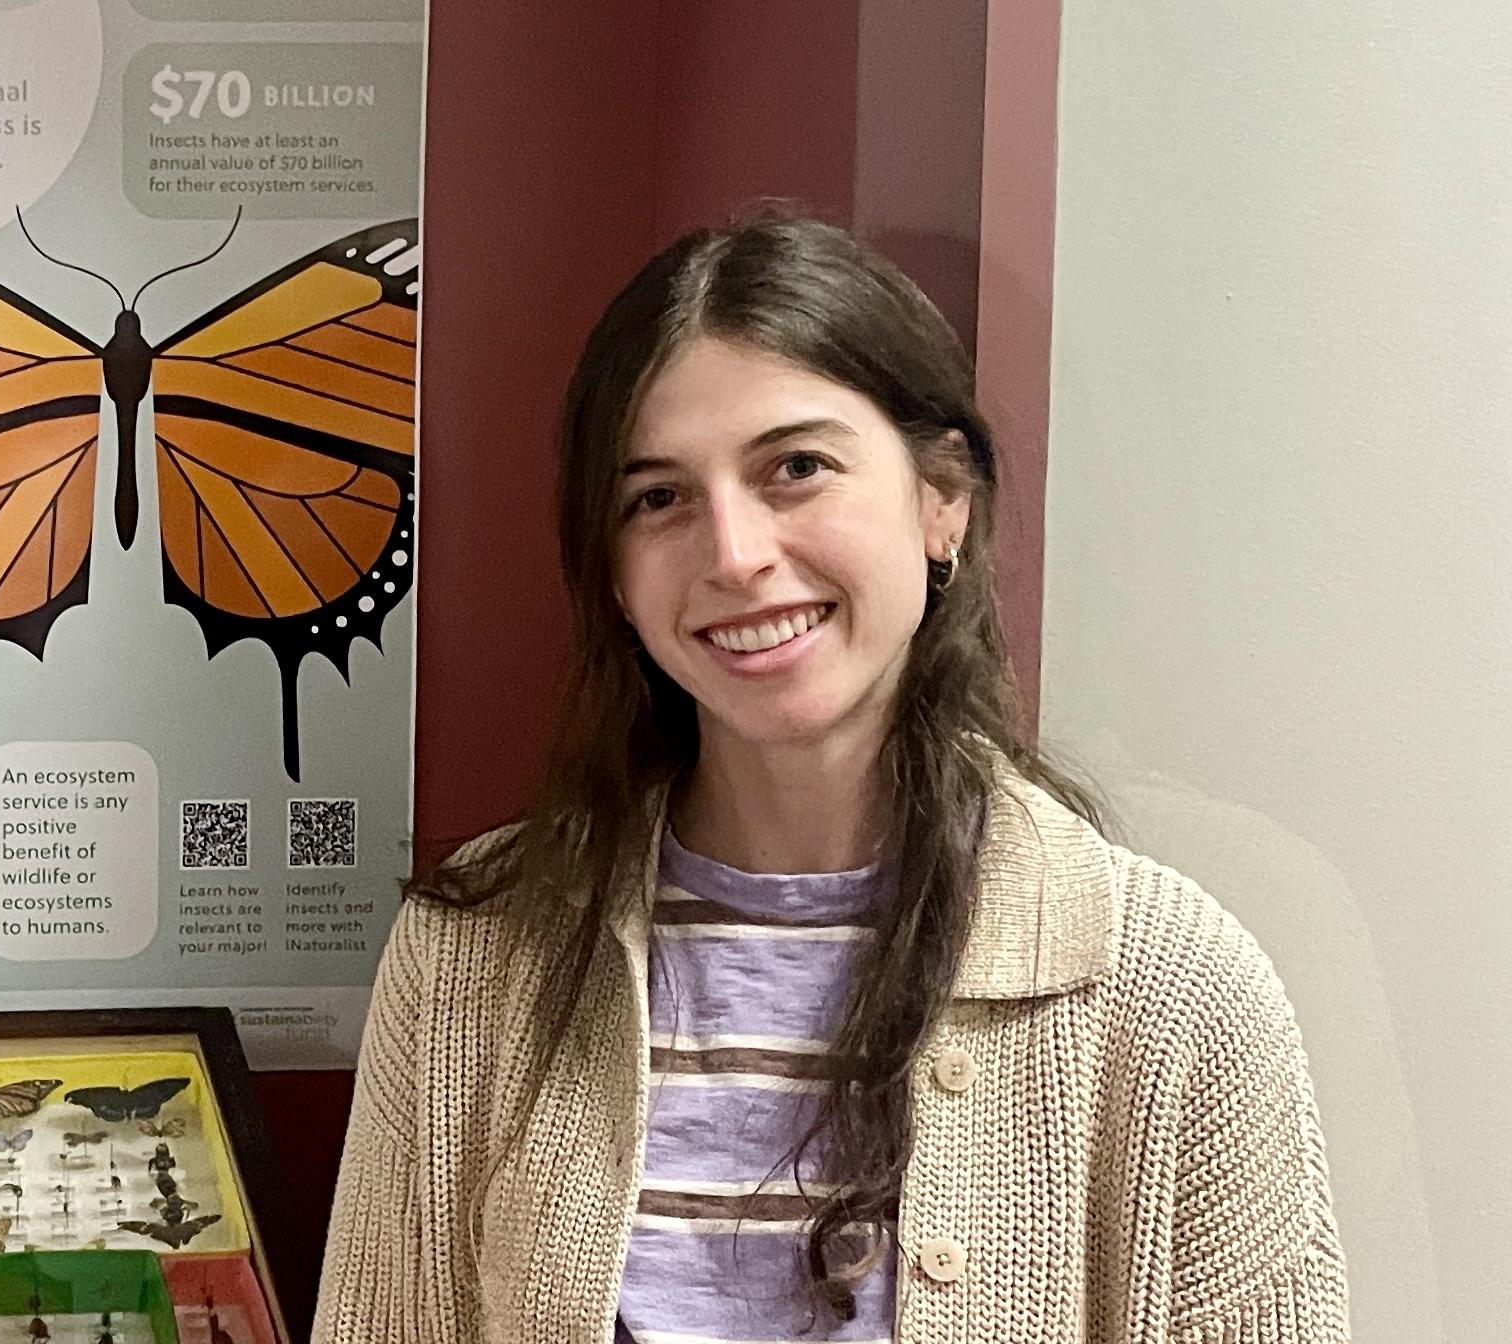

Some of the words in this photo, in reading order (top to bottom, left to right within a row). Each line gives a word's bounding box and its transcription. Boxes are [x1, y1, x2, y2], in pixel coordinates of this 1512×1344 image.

[149, 65, 250, 123] $70
[264, 85, 373, 107] BILLION
[23, 114, 41, 136] is
[150, 133, 205, 148] Insects
[211, 133, 249, 148] have
[254, 135, 270, 148] at
[275, 133, 313, 148] least
[318, 136, 342, 148] an
[149, 155, 205, 170] annual
[210, 156, 253, 170] value
[258, 154, 275, 170] of
[279, 155, 307, 172] $70
[311, 155, 363, 174] billion
[149, 176, 170, 192] for
[177, 176, 214, 192] their
[219, 180, 304, 195] ecosystem
[310, 177, 378, 193] services.
[2, 769, 27, 784] An
[34, 770, 134, 787] ecosystem
[3, 794, 67, 810] service
[75, 793, 88, 809] is
[94, 797, 128, 813] any
[3, 819, 76, 839] positive
[3, 843, 70, 860] benefit
[77, 842, 96, 859] of
[2, 867, 70, 884] wildlife
[77, 872, 96, 884] or
[180, 886, 222, 897] Learn
[228, 885, 259, 897] how
[2, 895, 112, 913] ecosystems
[180, 904, 232, 916] insects
[238, 905, 261, 915] are
[2, 921, 20, 935] to
[28, 919, 109, 934] humans.
[179, 922, 241, 934] relevant
[247, 922, 262, 933] to
[179, 943, 212, 955] your
[217, 939, 266, 955] major!
